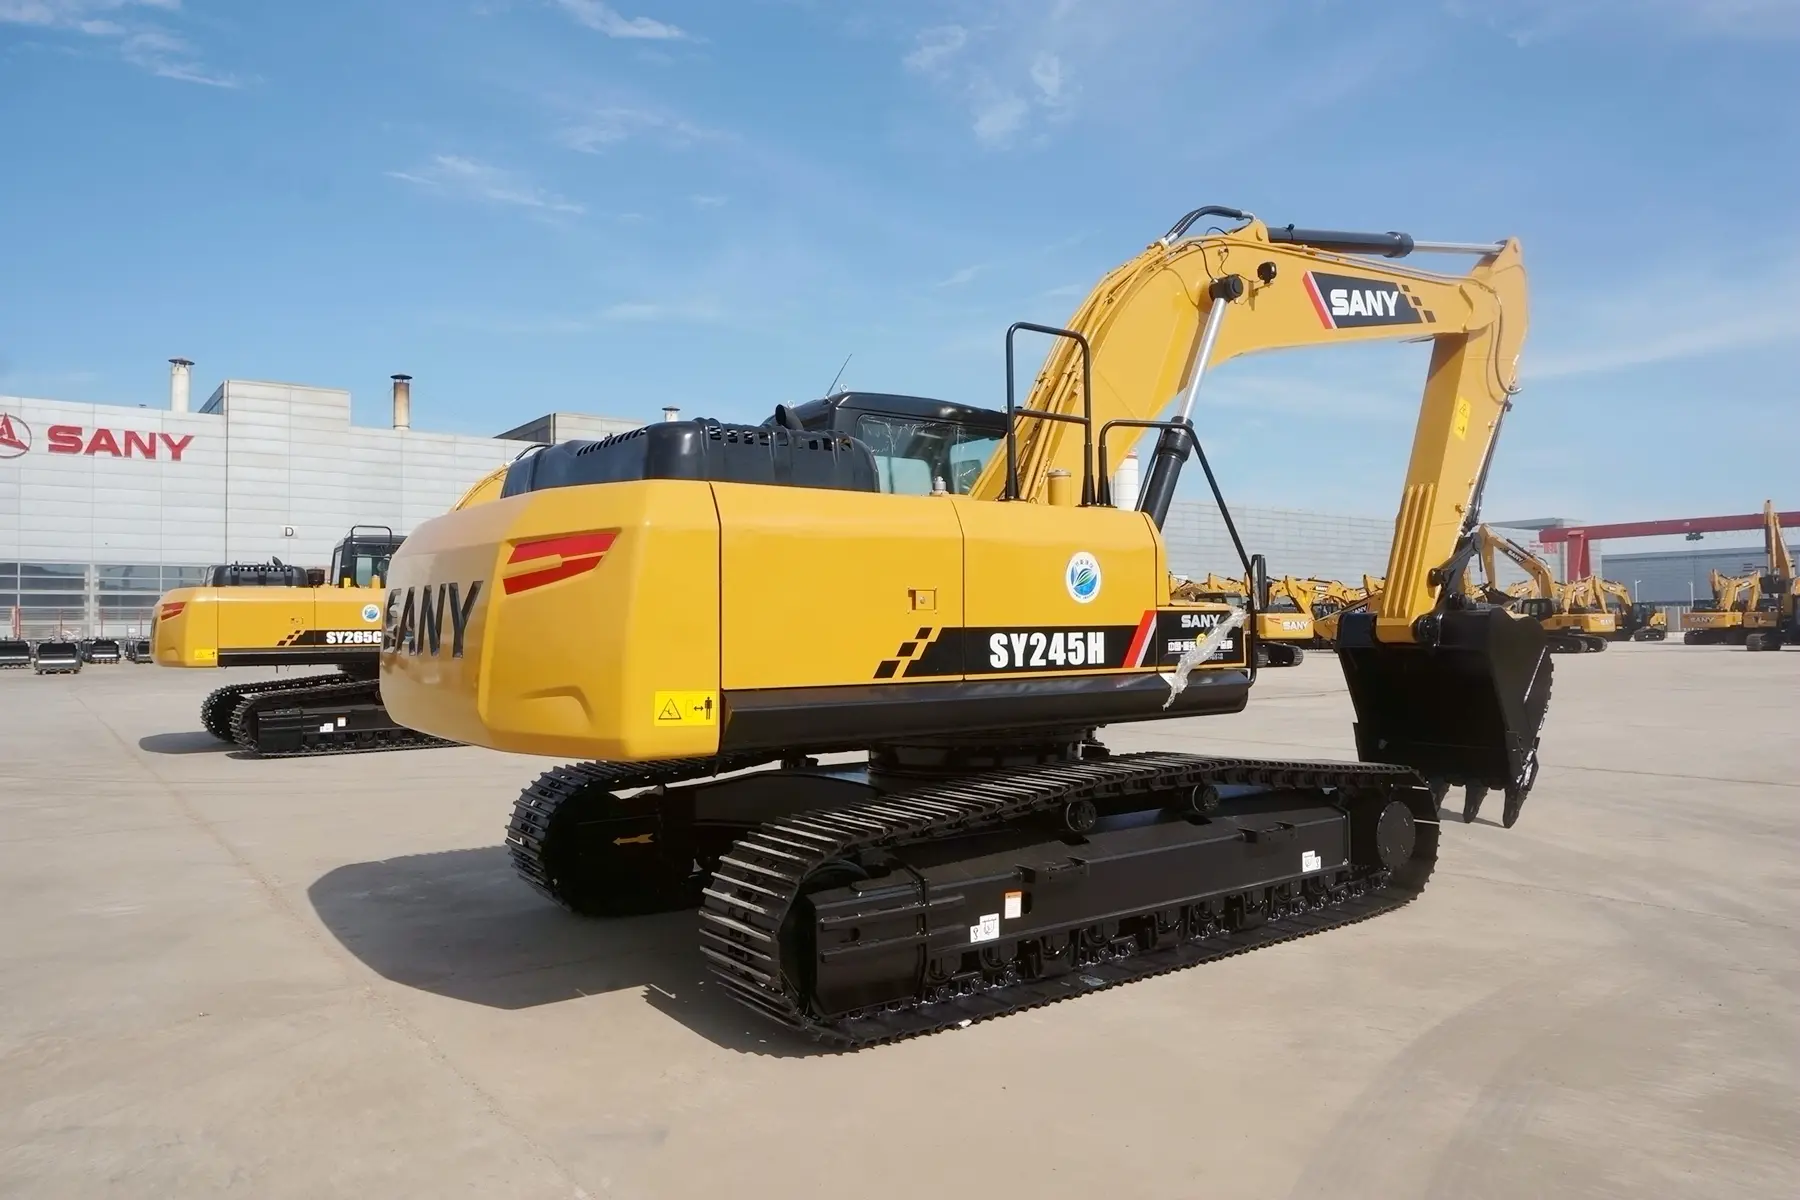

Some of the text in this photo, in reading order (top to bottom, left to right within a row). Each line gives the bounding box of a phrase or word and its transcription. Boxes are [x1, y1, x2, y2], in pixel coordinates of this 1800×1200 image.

[1330, 289, 1399, 316] SANY
[48, 424, 195, 462] SANY
[284, 526, 295, 537] D
[1181, 614, 1220, 628] SANY
[1282, 620, 1309, 631] SANY
[326, 631, 382, 644] SY265C
[989, 631, 1105, 669] SY245H
